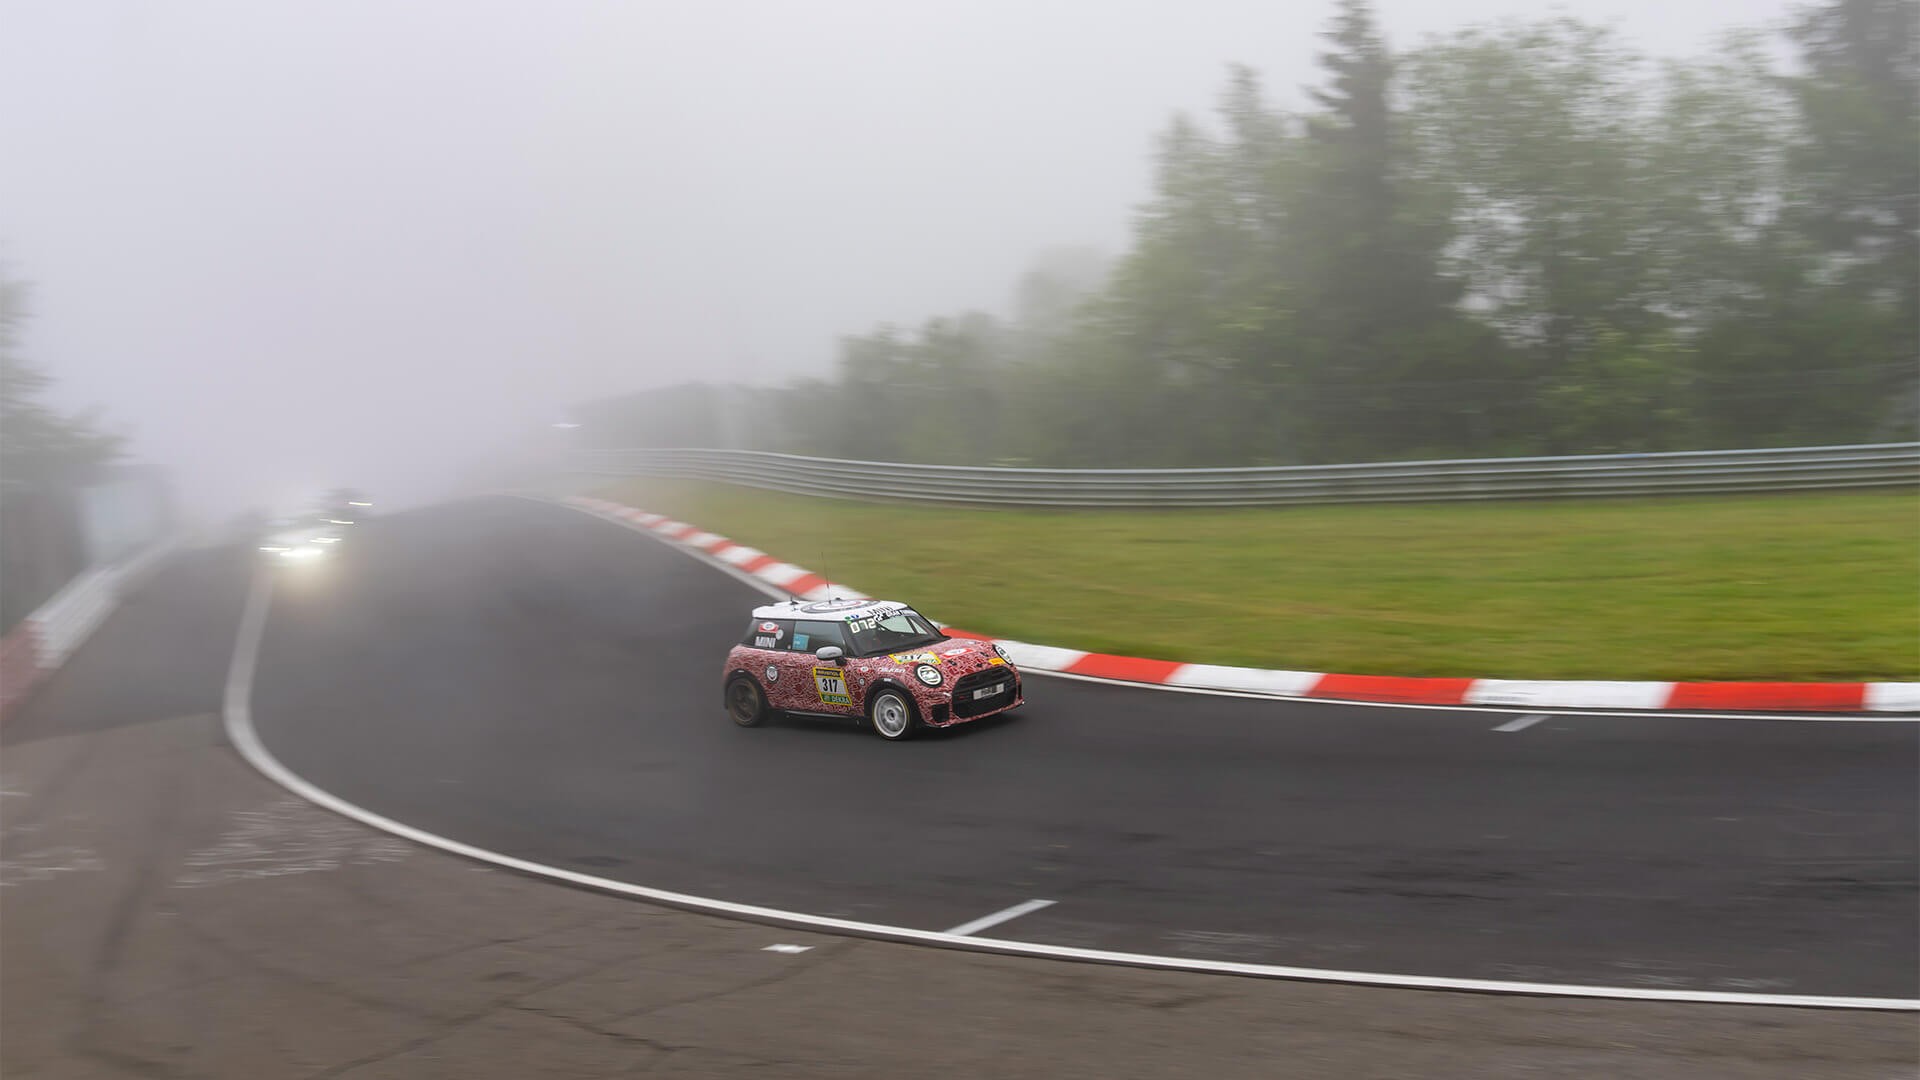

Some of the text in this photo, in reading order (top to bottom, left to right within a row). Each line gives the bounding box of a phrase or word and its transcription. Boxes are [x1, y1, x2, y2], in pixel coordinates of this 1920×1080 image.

[850, 618, 877, 633] 072
[755, 635, 776, 648] MINI
[822, 678, 838, 693] 317
